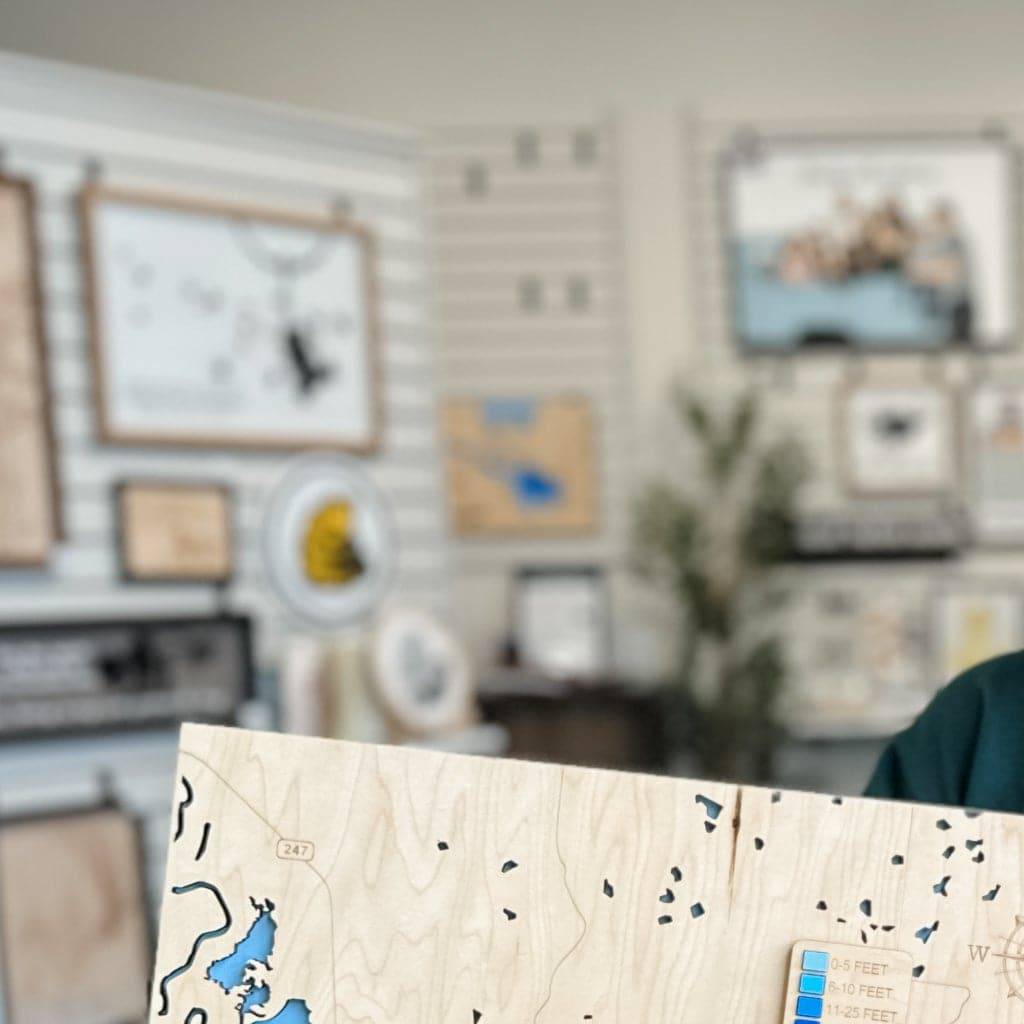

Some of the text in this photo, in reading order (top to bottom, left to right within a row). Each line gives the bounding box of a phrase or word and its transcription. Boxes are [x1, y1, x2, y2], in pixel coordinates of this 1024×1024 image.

[284, 844, 309, 856] 247
[967, 944, 991, 963] W
[831, 958, 889, 975] 0-5 FEET
[828, 981, 894, 999] 6-10 FEET
[826, 1004, 898, 1023] 11-25 FEET
